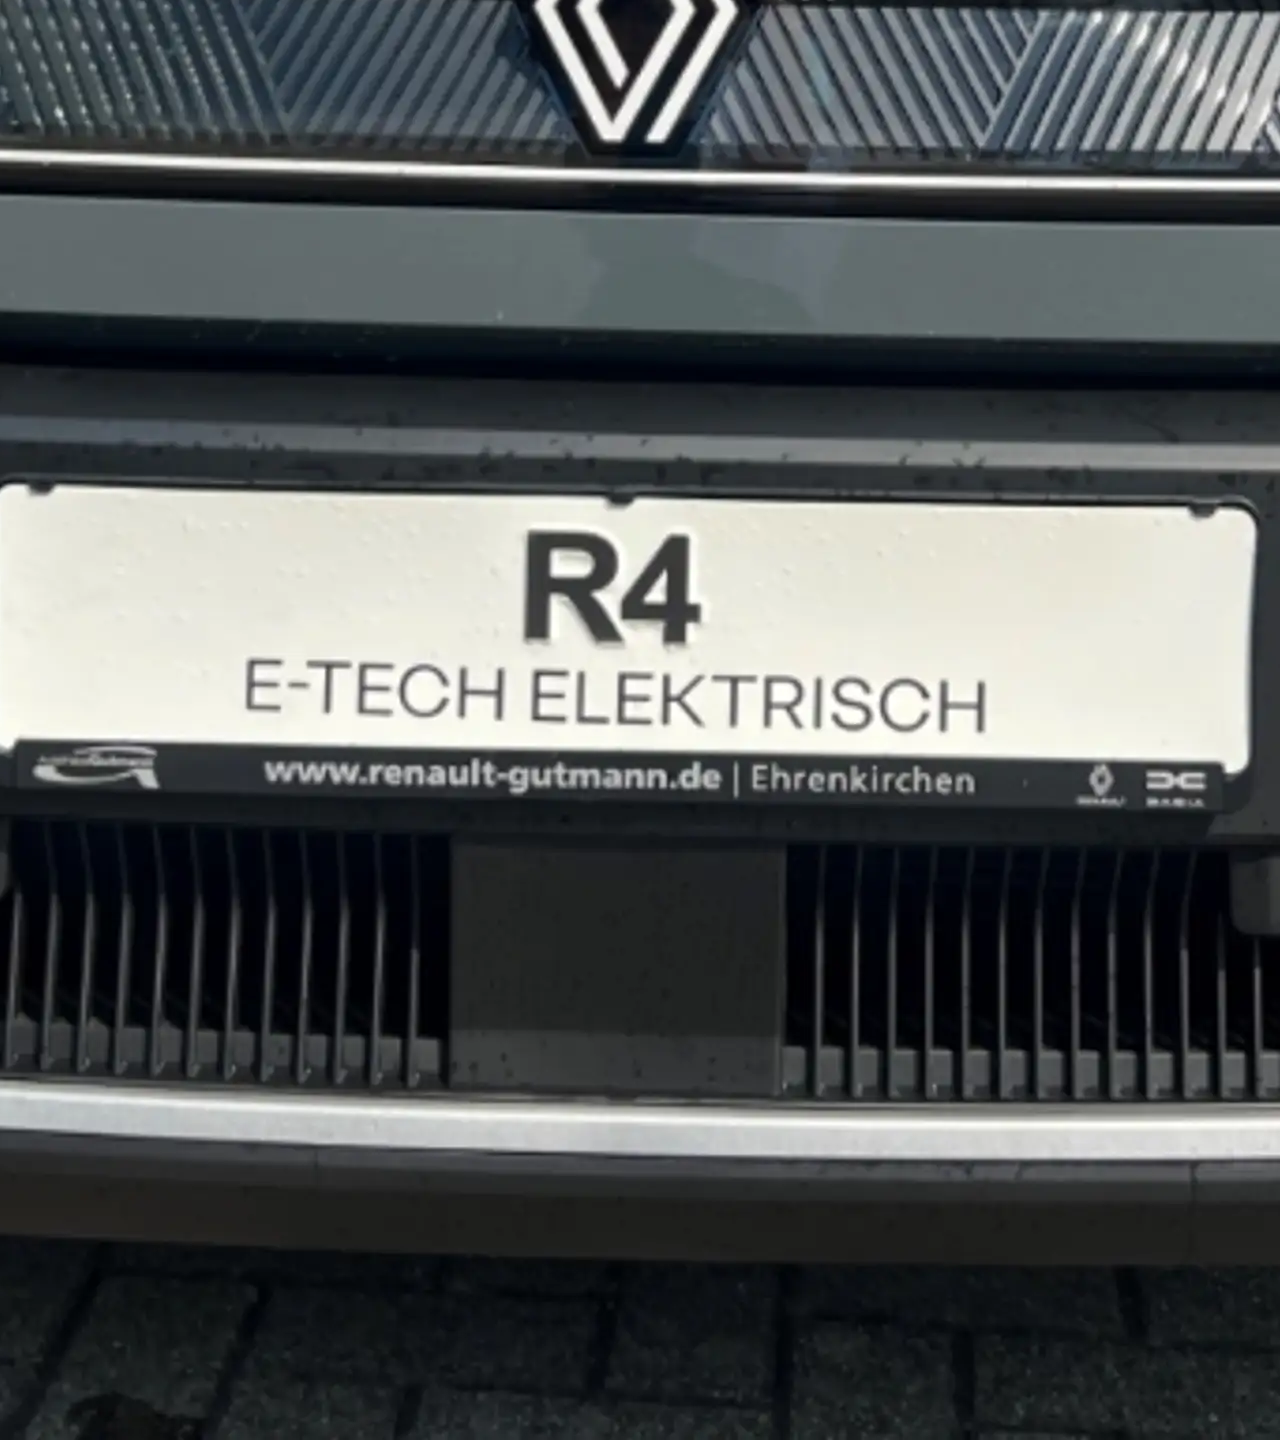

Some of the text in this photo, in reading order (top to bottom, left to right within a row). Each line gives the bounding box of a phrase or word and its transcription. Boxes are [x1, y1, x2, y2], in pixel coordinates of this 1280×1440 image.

[524, 530, 701, 645] R4
[246, 658, 986, 733] E-TECH ELEKTRISCH
[264, 758, 975, 794] www.renault-gutmann.de Ehrenkirchen
